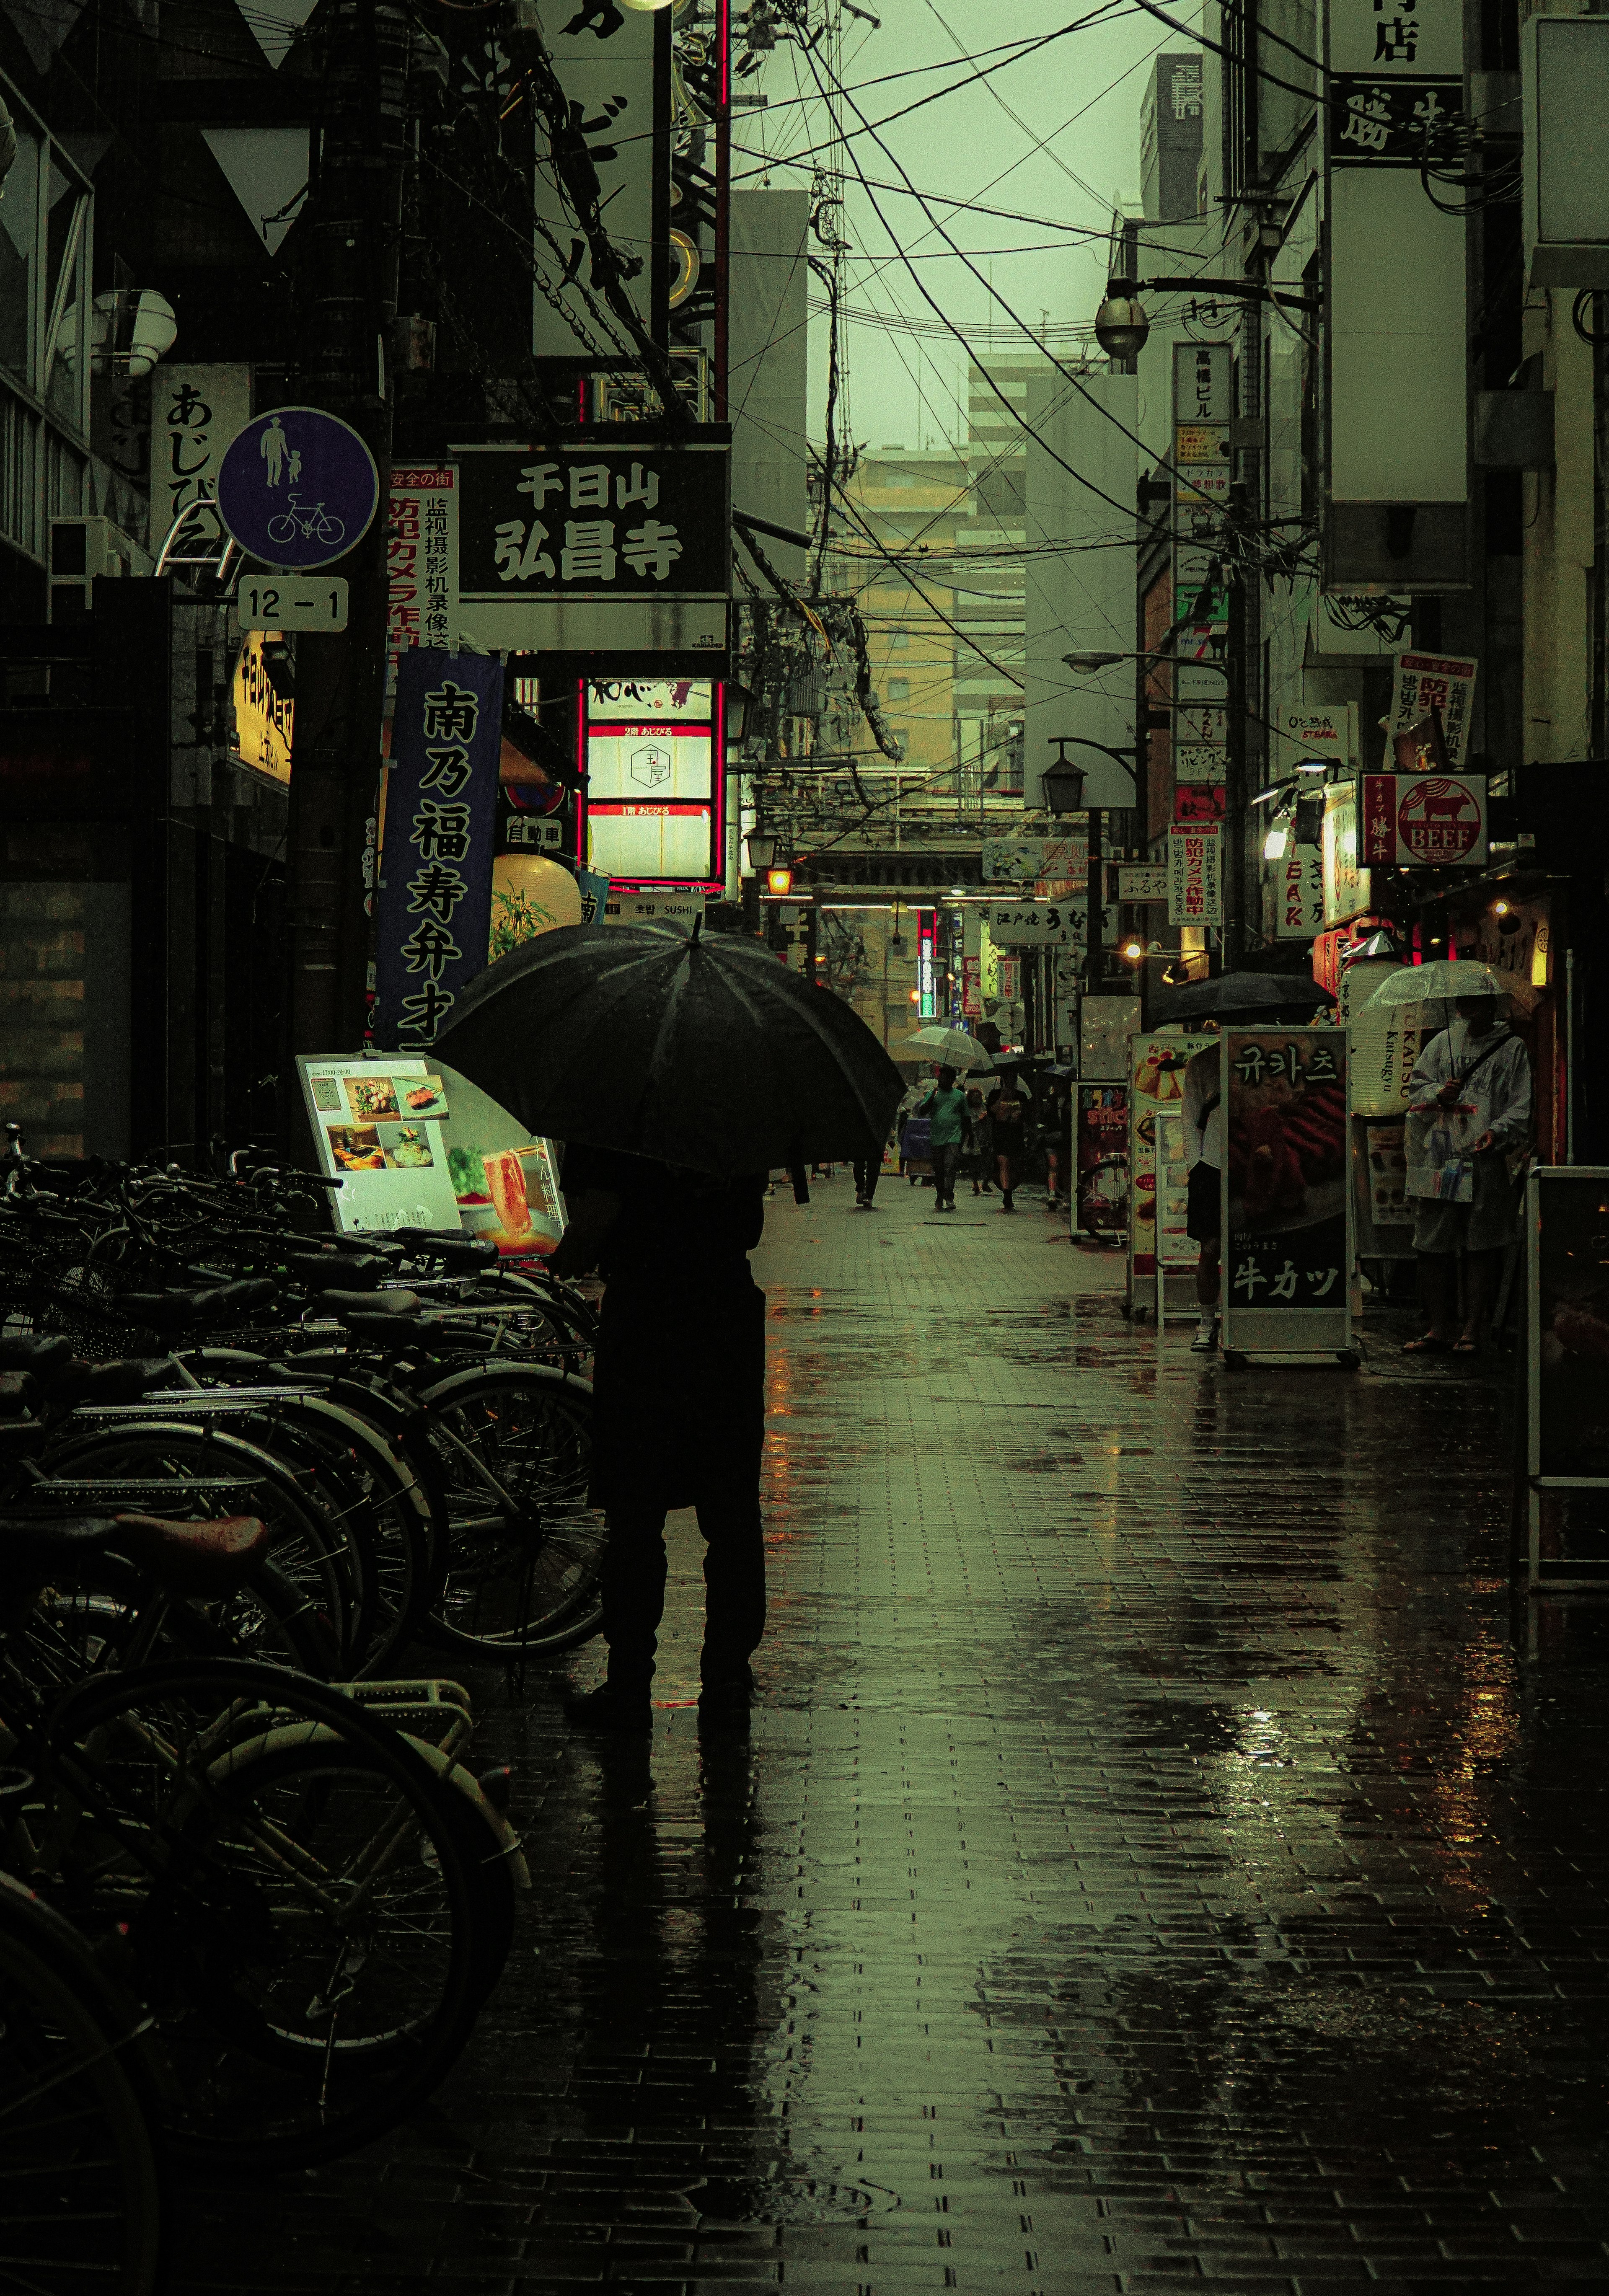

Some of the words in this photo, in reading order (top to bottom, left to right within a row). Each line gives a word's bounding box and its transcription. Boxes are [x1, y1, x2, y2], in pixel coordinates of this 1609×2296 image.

[1196, 350, 1212, 419] 高橋ビル
[516, 462, 660, 510] 千日山
[494, 520, 683, 581] 弘昌寺
[1397, 674, 1418, 729] 방범카
[1419, 677, 1449, 712] 防犯
[624, 727, 639, 736] 2階
[641, 727, 672, 736] あじびる
[623, 807, 636, 815] 1階
[638, 807, 669, 815] あじびる
[1375, 778, 1384, 812] 牛カツ
[509, 825, 559, 843] 自動車
[1370, 815, 1392, 860] 勝牛
[1410, 828, 1469, 849] BEEF
[399, 680, 479, 1051] 南乃福寿弁才
[1185, 838, 1204, 915] 防犯カメラ作動中
[635, 905, 655, 915] 초밥
[664, 905, 692, 914] SUSHI
[1234, 1043, 1338, 1085] 규카츠
[1381, 1031, 1399, 1092] Katsugyu
[1234, 1256, 1339, 1301] 牛カツ
